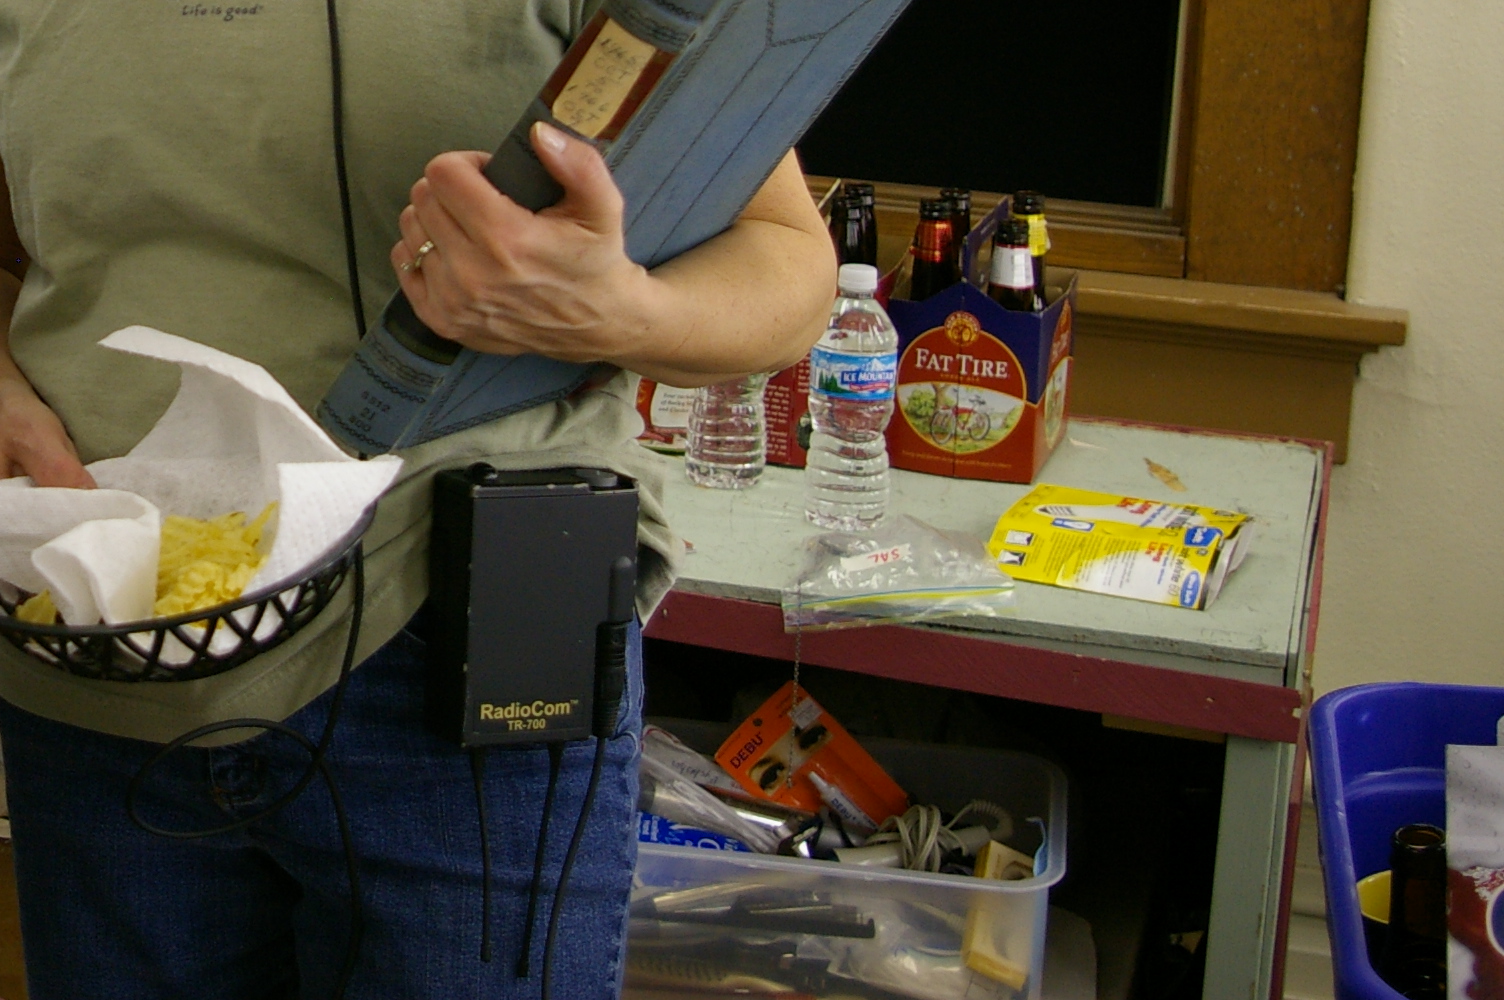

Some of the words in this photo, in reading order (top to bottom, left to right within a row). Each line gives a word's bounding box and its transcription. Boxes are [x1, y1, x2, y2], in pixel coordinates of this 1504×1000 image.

[182, 3, 207, 17] Life
[210, 6, 222, 16] is
[224, 4, 259, 22] good
[914, 347, 954, 373] FAT
[956, 353, 1009, 379] TIRE
[843, 372, 857, 382] ICE
[479, 700, 571, 721] RadioCom
[507, 718, 547, 732] TR-700
